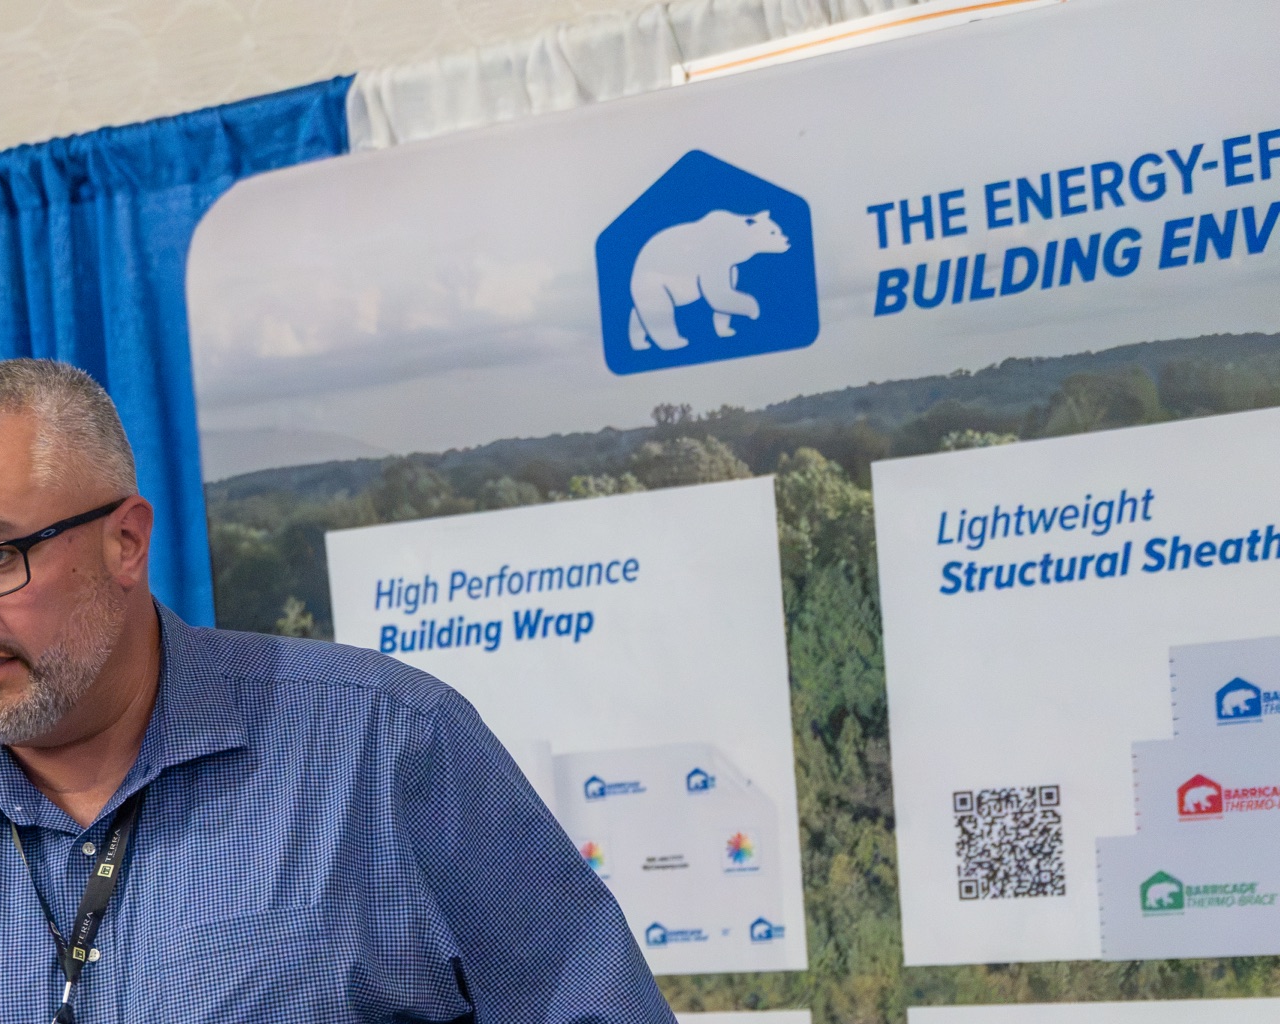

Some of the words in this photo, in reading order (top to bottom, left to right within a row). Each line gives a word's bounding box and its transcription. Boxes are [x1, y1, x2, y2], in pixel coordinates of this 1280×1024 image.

[866, 188, 968, 250] THE
[983, 127, 1280, 229] ENERGY-EF
[873, 226, 1143, 318] BUILDING
[1158, 201, 1280, 271] ENV
[936, 487, 1155, 551] Lightweight
[374, 574, 439, 614] High
[448, 555, 640, 602] Performance
[939, 540, 1132, 595] Structural
[1141, 526, 1280, 574] Sheath
[379, 616, 502, 654] Building
[513, 608, 595, 643] Wrap
